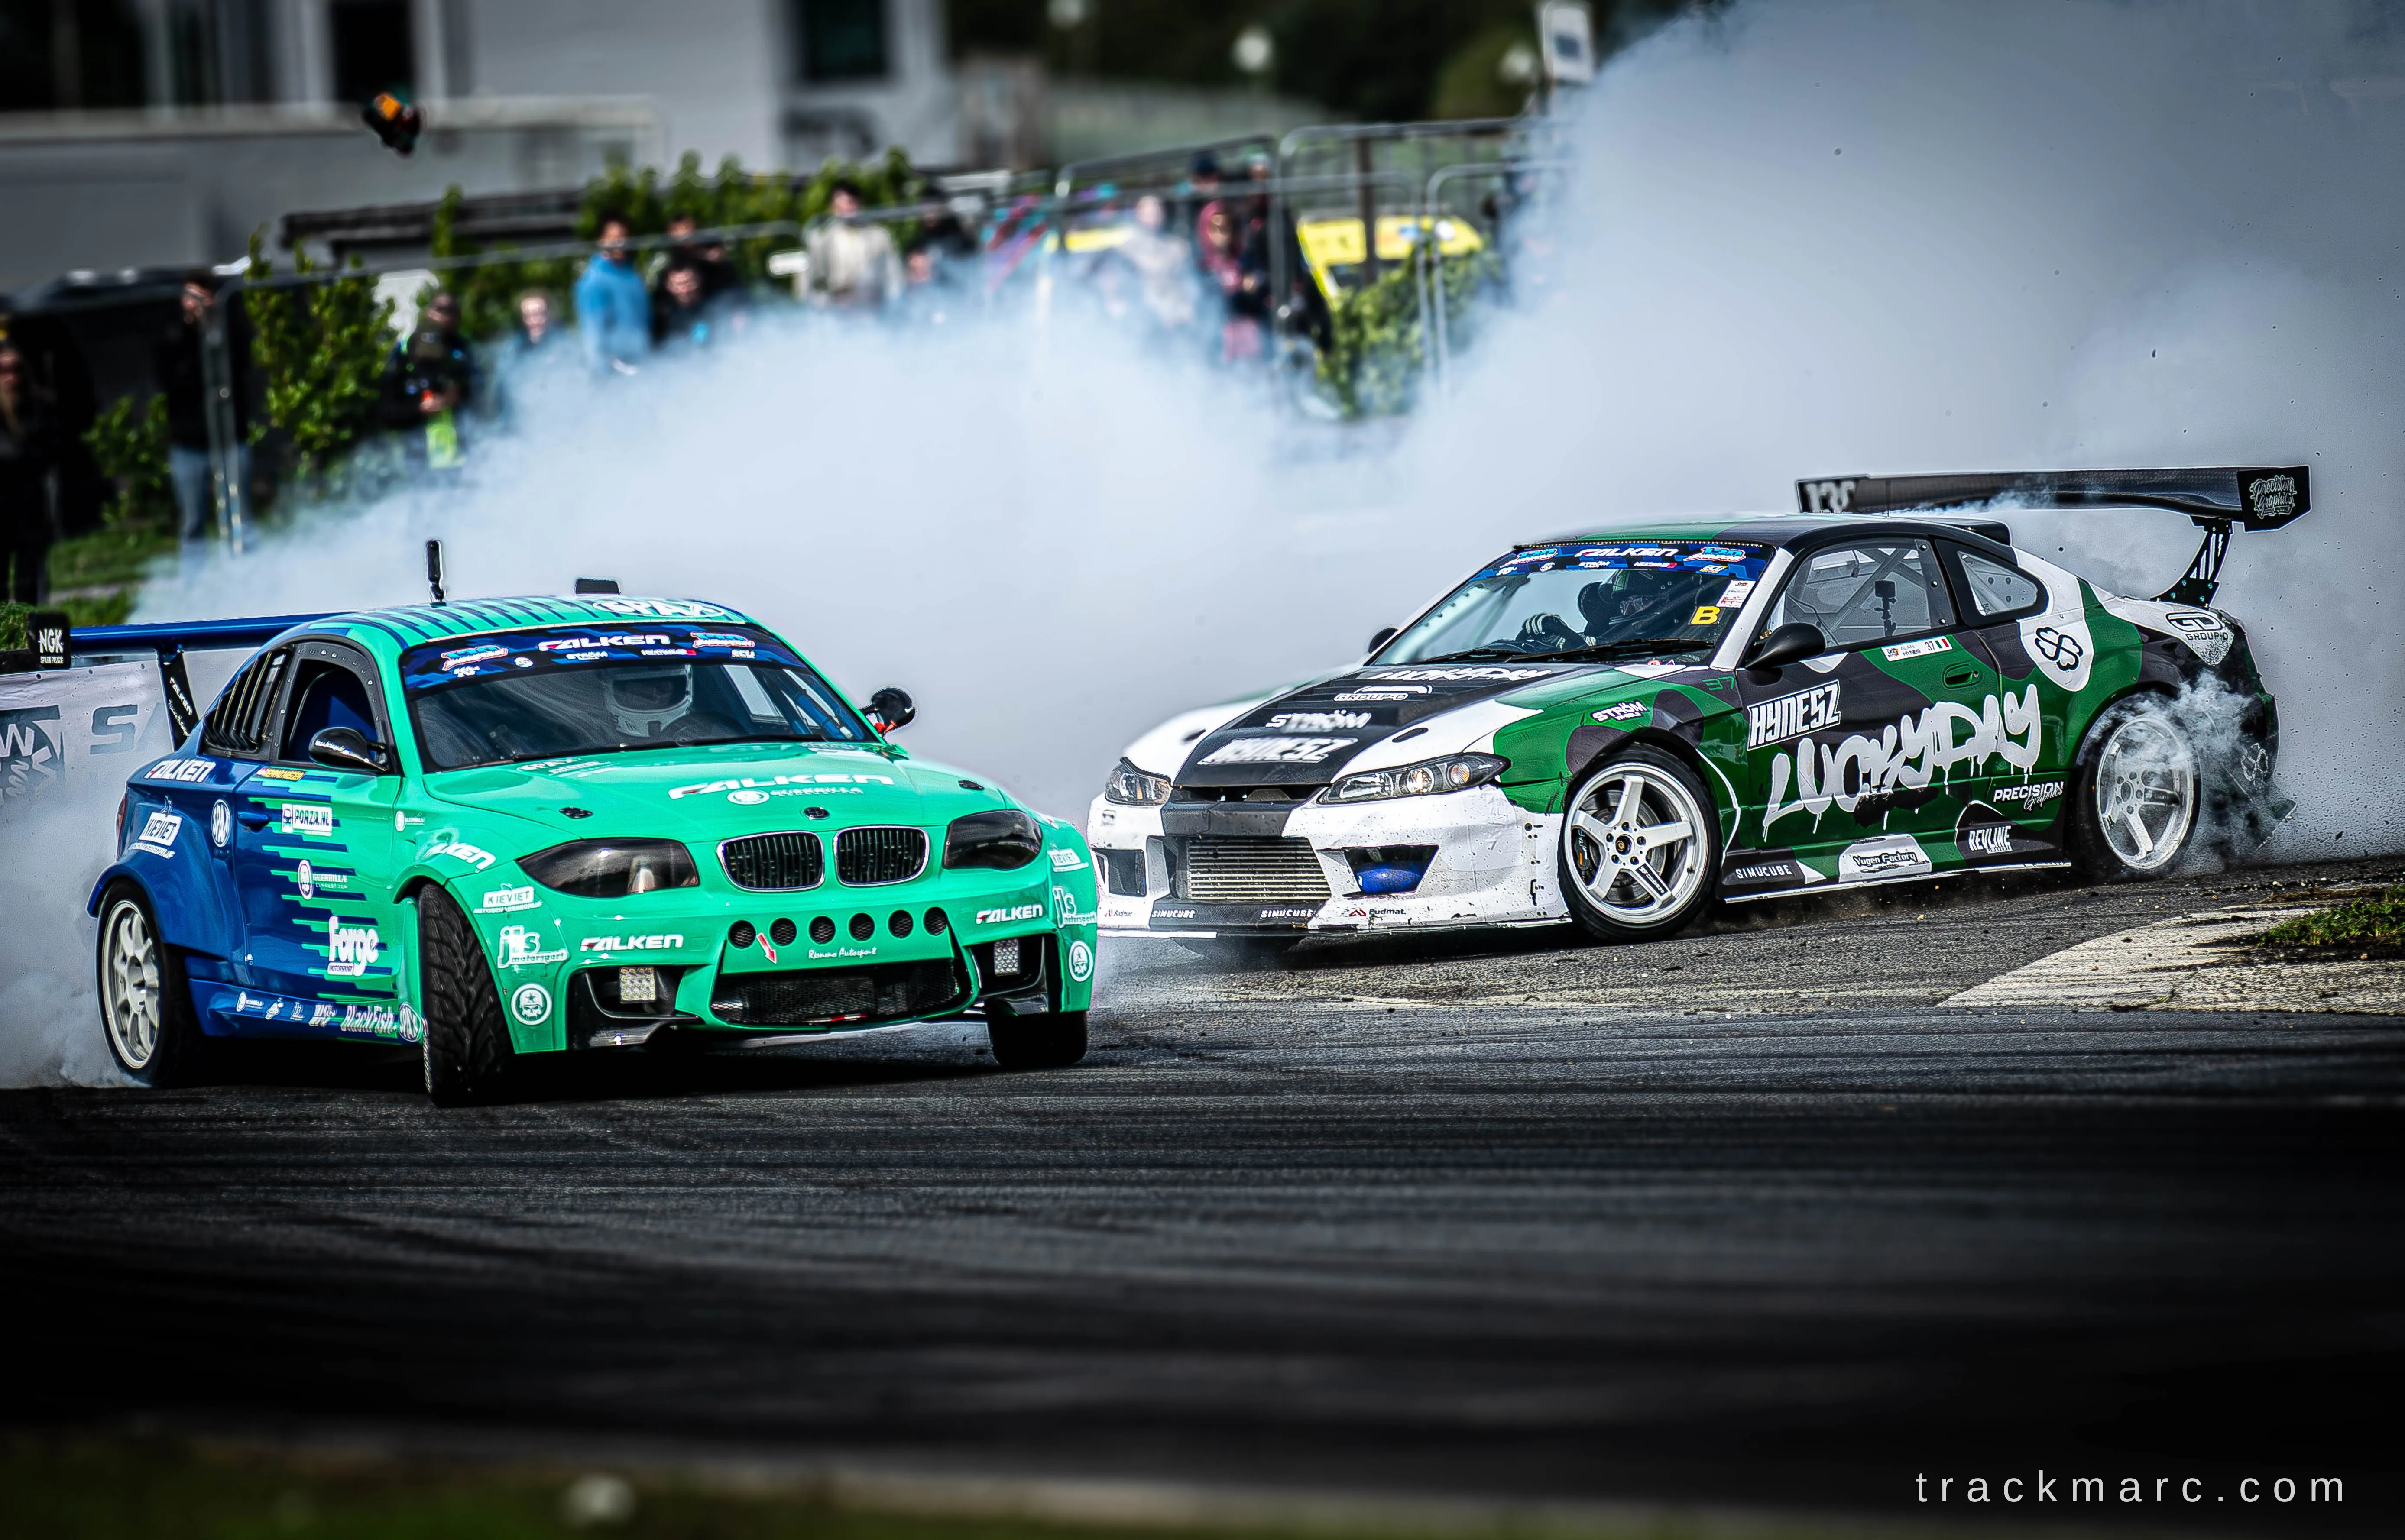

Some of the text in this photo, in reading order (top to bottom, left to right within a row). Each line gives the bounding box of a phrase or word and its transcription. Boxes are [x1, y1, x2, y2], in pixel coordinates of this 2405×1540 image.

[1574, 548, 1679, 557] FALKEN
[1691, 606, 1720, 624] B
[38, 629, 64, 653] NGK
[538, 634, 671, 651] FALKEN
[1925, 641, 1935, 651] 37
[1703, 676, 1734, 691] 37
[1592, 702, 1648, 721] STRÖM
[1750, 683, 1840, 747] HYNESZ
[144, 759, 216, 783] FALKEN
[668, 774, 894, 799] FALKEN
[1993, 781, 2064, 802] PRECISION
[294, 809, 330, 827] PORZA.NL
[1968, 826, 2011, 851] REVLINE
[1853, 852, 1918, 867] Yugen Factory
[1735, 865, 1792, 879] SIMUCUBE
[488, 890, 530, 904] KIEVIET
[976, 905, 1043, 924] FALKEN
[1151, 910, 1196, 918] SIMUCUBE
[1261, 909, 1314, 918] SIMUCUBE
[329, 916, 379, 976] Forge
[580, 935, 683, 951] FALKEN
[511, 952, 564, 963] motorsport
